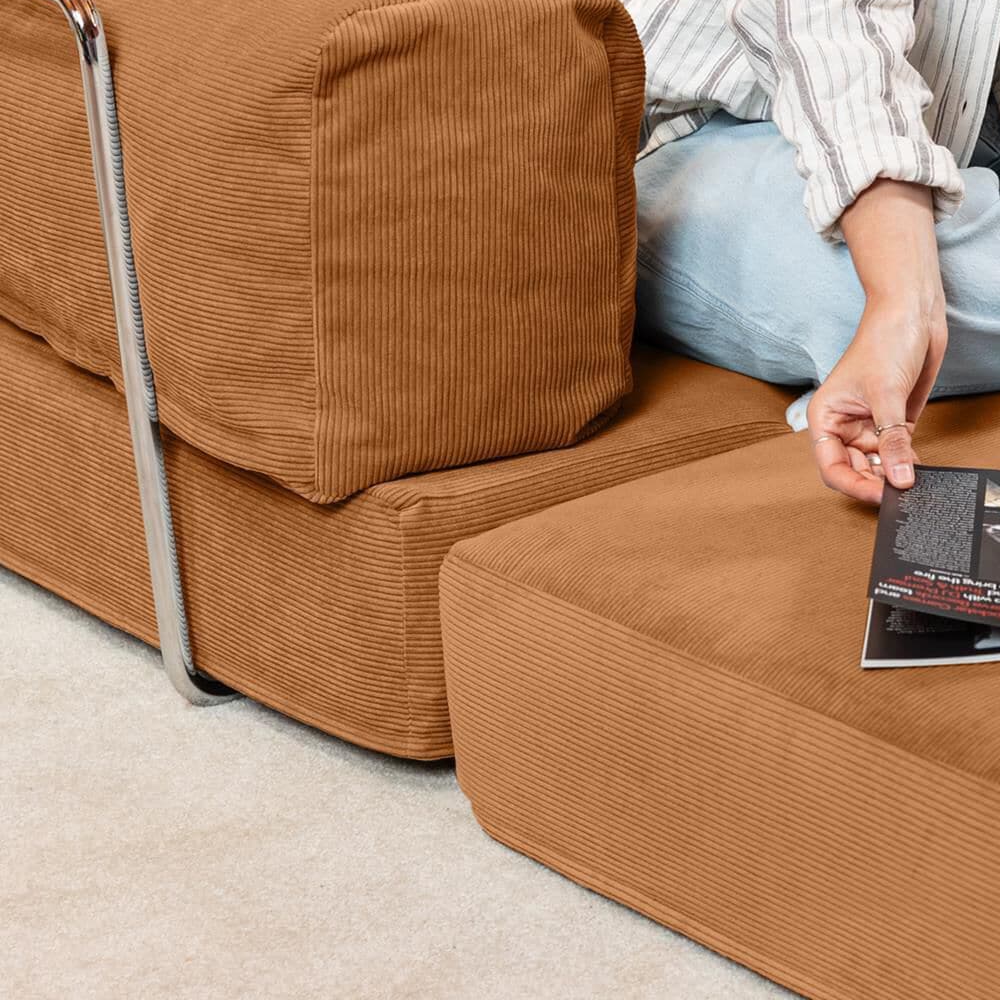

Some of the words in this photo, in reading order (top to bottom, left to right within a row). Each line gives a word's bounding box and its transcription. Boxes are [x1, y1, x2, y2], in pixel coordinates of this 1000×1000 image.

[913, 570, 934, 579] fire
[938, 575, 960, 584] the
[962, 578, 996, 590] bring
[874, 588, 900, 597] and
[878, 582, 912, 595] team
[963, 592, 991, 602] with
